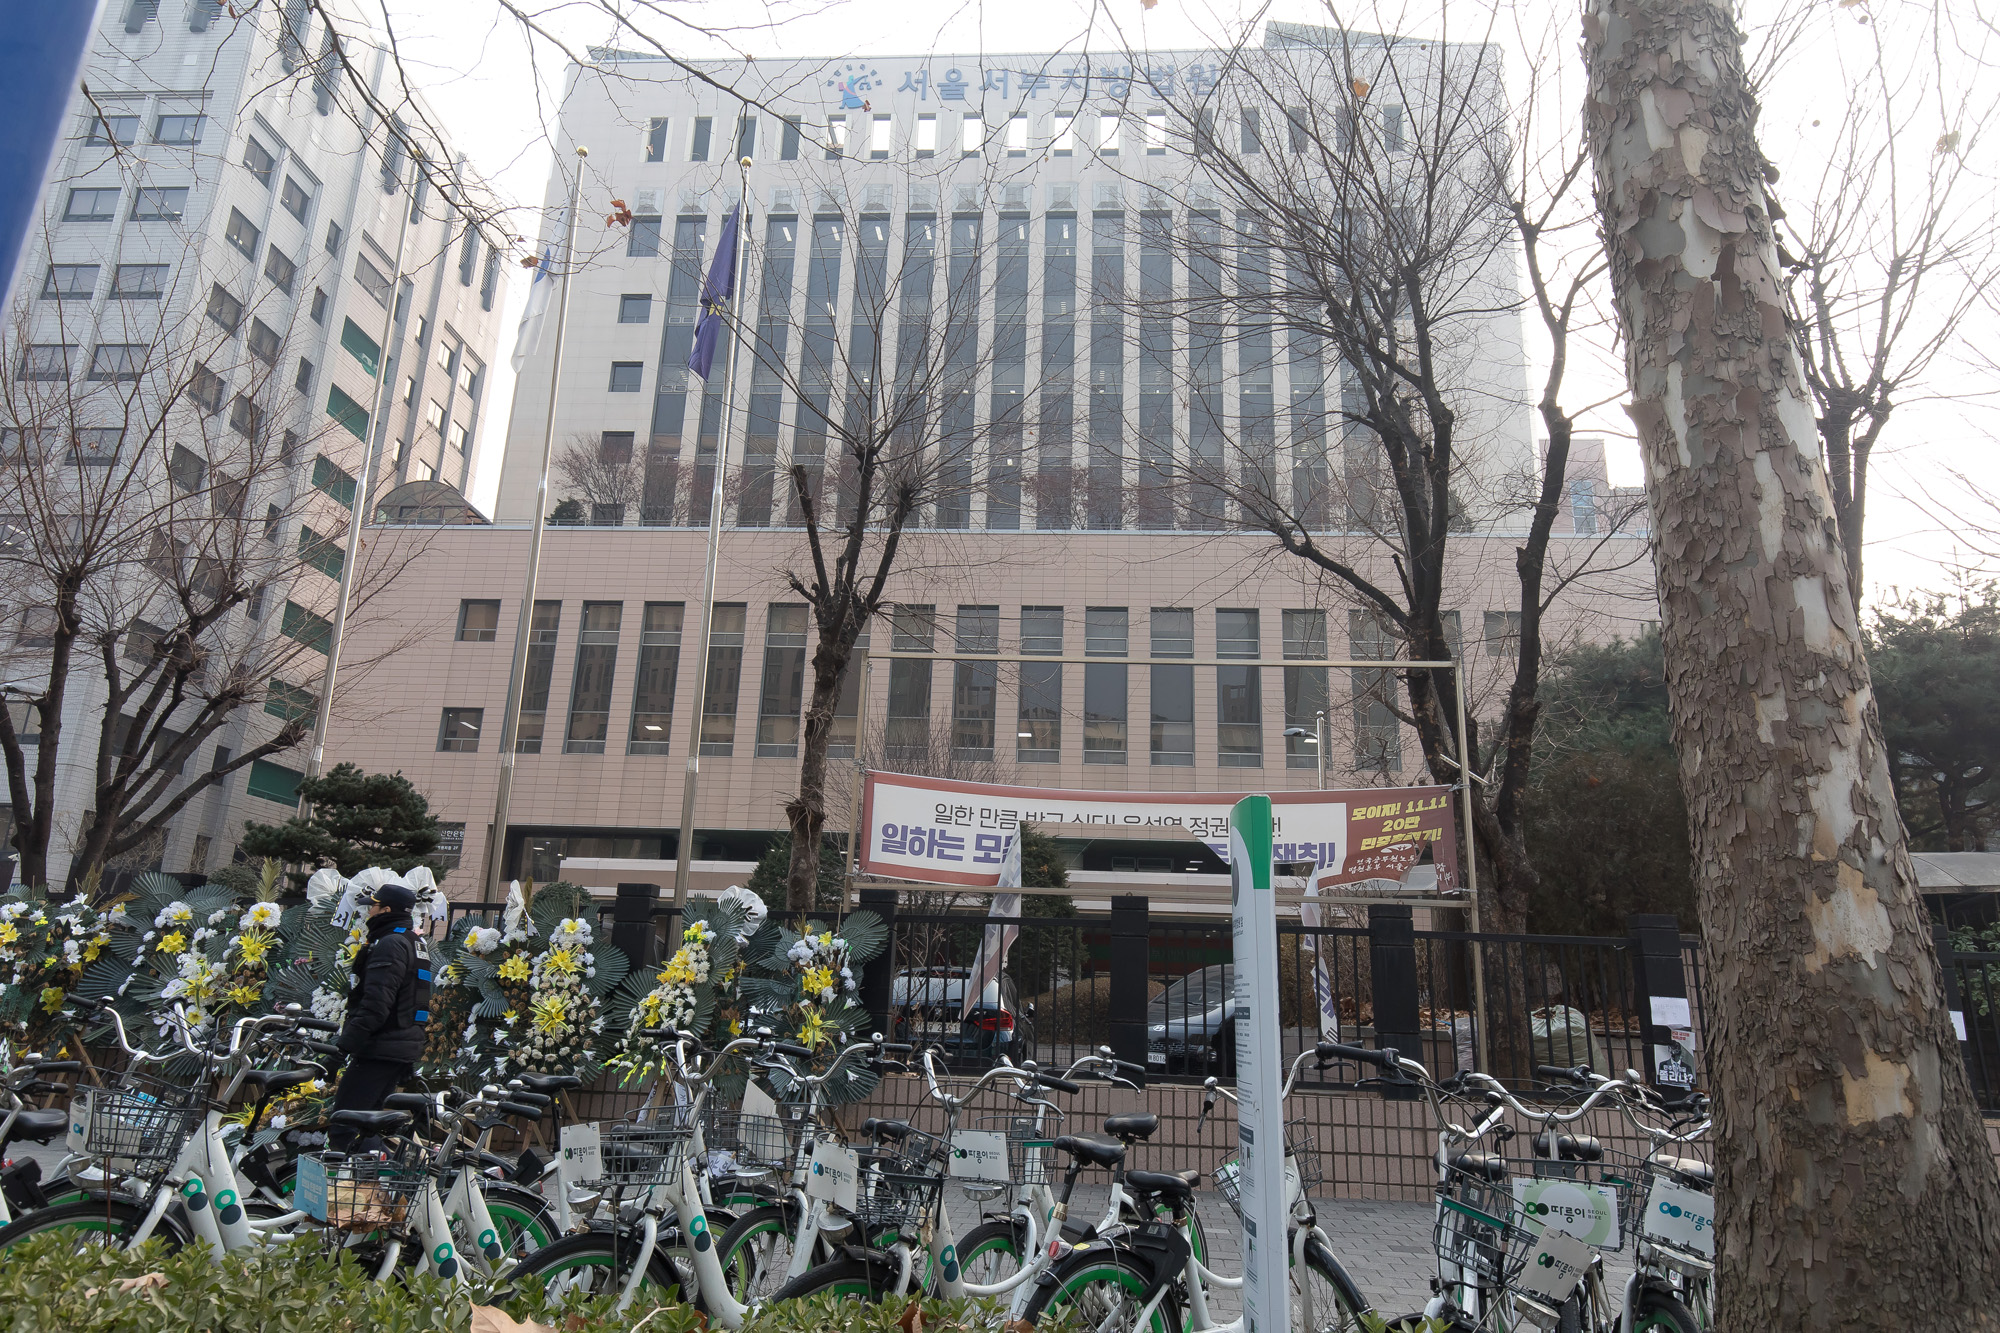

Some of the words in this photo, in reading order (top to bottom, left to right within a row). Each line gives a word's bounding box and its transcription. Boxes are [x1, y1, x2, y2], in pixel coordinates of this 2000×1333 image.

[1351, 802, 1402, 821] 모이자!
[1405, 796, 1448, 814] 11.11
[935, 803, 975, 827] 일한
[980, 808, 1018, 830] 만큼
[1189, 817, 1230, 838] 정권
[1381, 816, 1421, 832] 20만
[881, 823, 965, 862] 일하는
[573, 1146, 588, 1164] 따릉이
[968, 1150, 989, 1164] 따릉이
[825, 1166, 844, 1186] 따릉이
[1551, 1205, 1586, 1224] 따릉이
[1554, 1259, 1576, 1280] 따릉이
